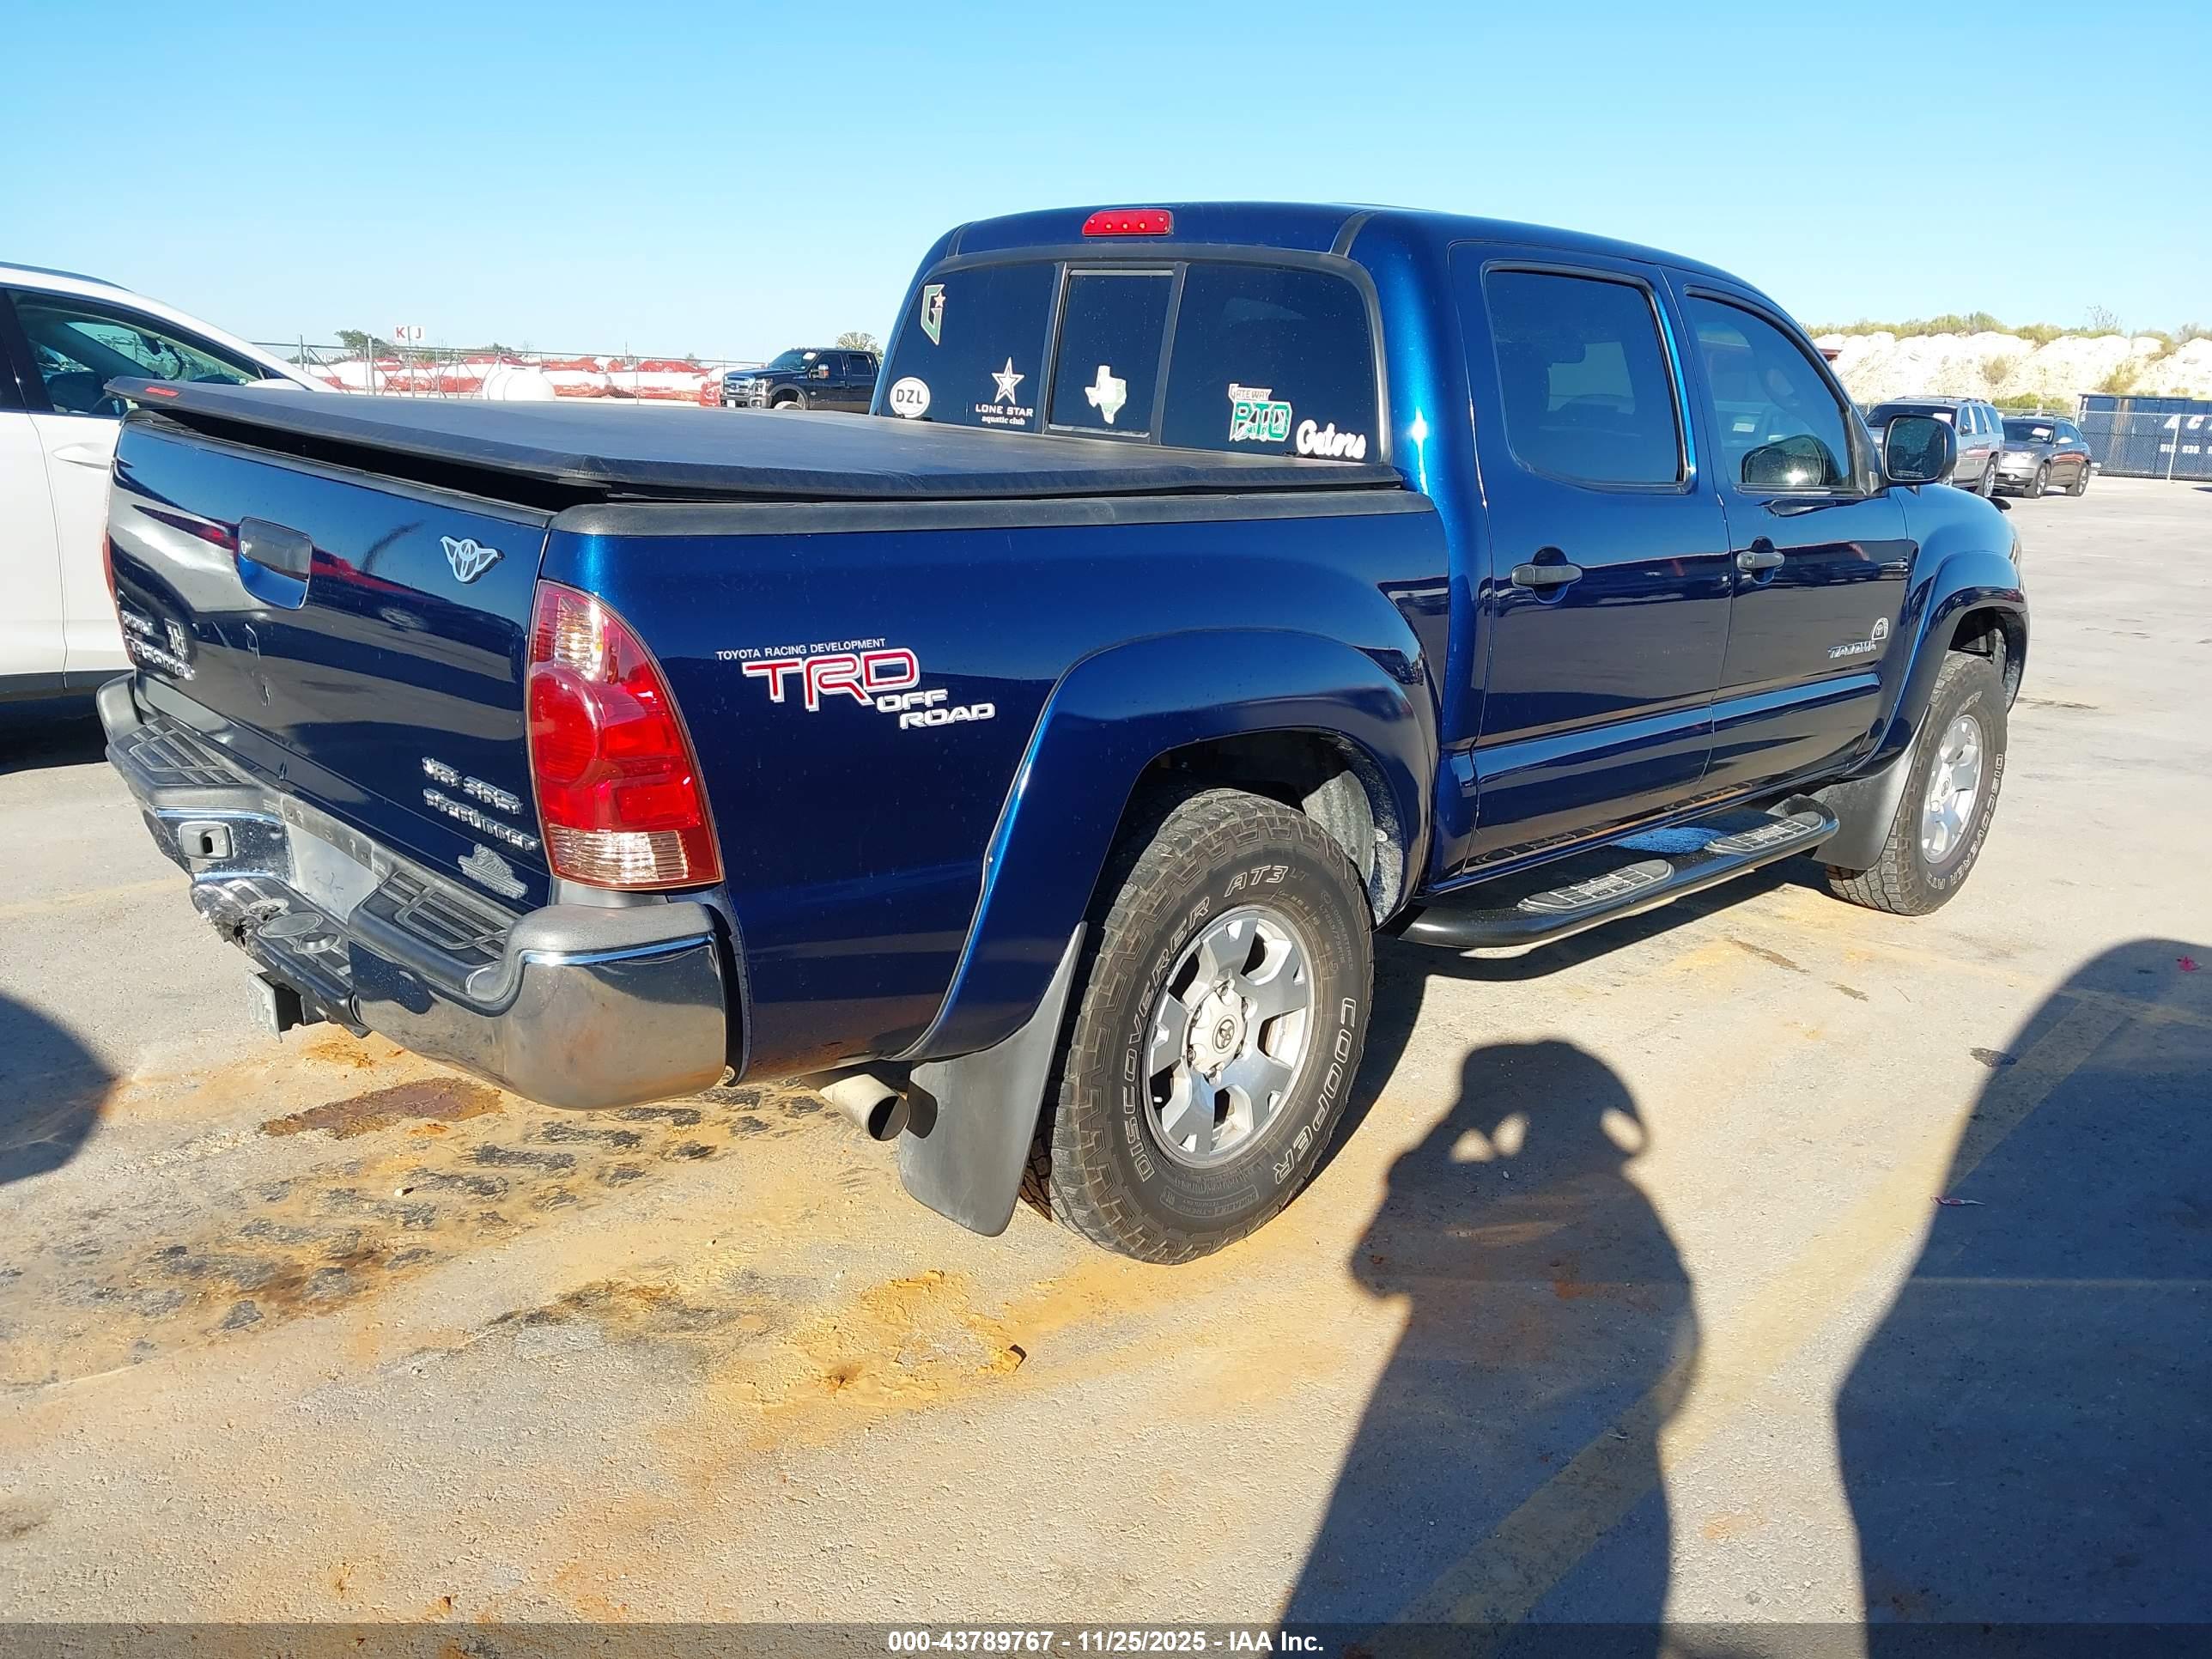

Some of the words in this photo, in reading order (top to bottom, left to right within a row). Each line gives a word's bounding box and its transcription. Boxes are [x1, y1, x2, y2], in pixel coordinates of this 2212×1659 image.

[396, 326, 405, 338] K
[416, 327, 422, 339] J
[896, 389, 924, 404] DZL
[975, 404, 1003, 414] LONE
[1006, 407, 1034, 417] STAR
[981, 416, 1008, 424] aquatic
[1009, 416, 1026, 426] club
[1232, 401, 1291, 441] PTO
[1297, 419, 1367, 459] Gators
[716, 649, 761, 661] TOYOTA
[764, 645, 807, 657] RACING
[811, 638, 886, 653] DEVELOPMENT
[742, 647, 921, 713] TRD
[876, 689, 948, 713] OFF
[900, 702, 995, 730] ROAD
[1950, 754, 2004, 886] DISCOVERER
[1123, 896, 1210, 1182] DISCOVERER
[1224, 865, 1289, 898] AT3
[1273, 997, 1357, 1185] COOPER
